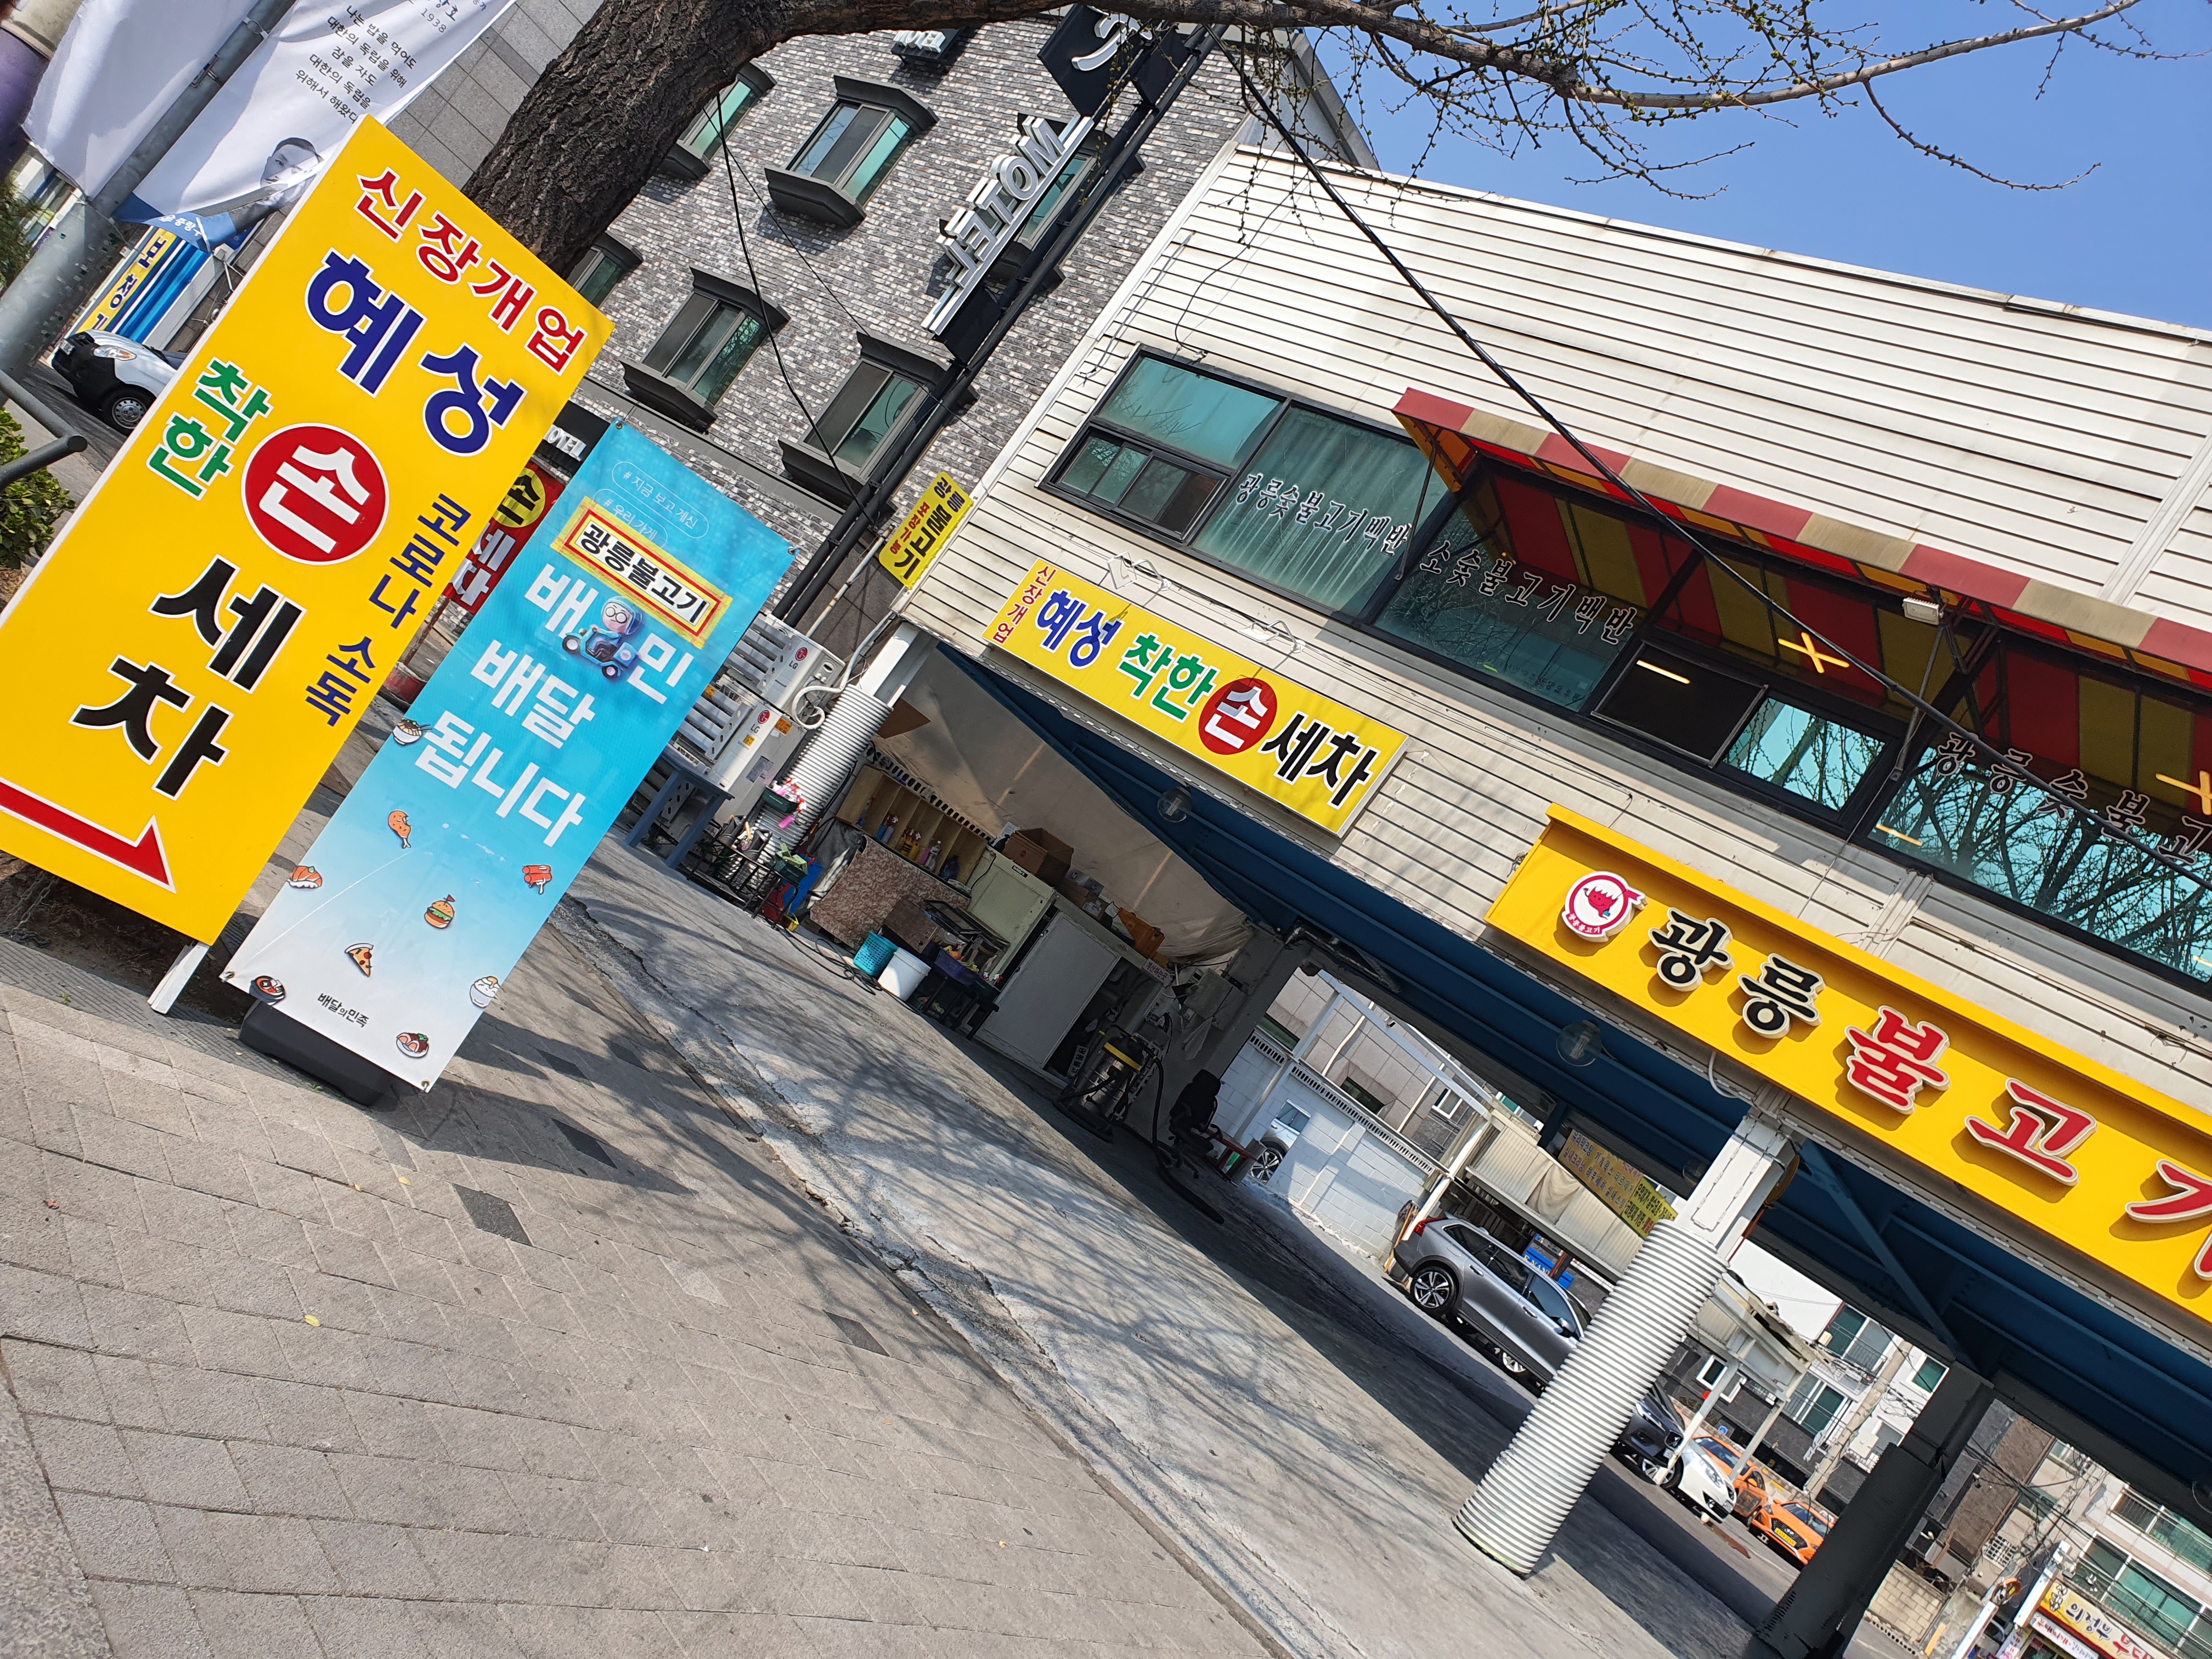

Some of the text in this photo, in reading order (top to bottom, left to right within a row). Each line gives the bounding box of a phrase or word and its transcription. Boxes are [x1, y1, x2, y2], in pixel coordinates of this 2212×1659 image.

[327, 16, 408, 89] 대한의 독립을 위해
[346, 5, 417, 70] 나는 밥을 먹어도
[421, 8, 447, 33] 1938
[295, 69, 330, 99] 위해서
[309, 54, 371, 110] 대한의 독립을
[332, 46, 377, 86] 잠을 자도
[356, 167, 588, 375] 신장개업
[306, 247, 528, 456] 혜성
[146, 357, 273, 500] 착한
[544, 424, 586, 461] OTEL
[259, 445, 372, 554] 손
[612, 504, 636, 526] 우리
[634, 519, 658, 541] 가게
[632, 476, 654, 498] 지금
[653, 492, 675, 514] 보고
[675, 507, 698, 529] 계신
[890, 501, 931, 555] 포장가능
[934, 477, 966, 512] 광릉
[1235, 472, 1412, 557] 광릉숯불고기백반
[580, 523, 707, 623] 광릉불고기
[894, 504, 953, 580] 불고기
[304, 493, 471, 727] 코로나 소독
[992, 566, 1057, 645] 신장개업
[1419, 539, 1637, 645] 소숯불고기백반
[69, 554, 307, 800] 세차
[470, 639, 596, 748] 배달
[789, 661, 798, 669] LG
[1035, 589, 1381, 810] 혜성 착한 손 세차
[750, 724, 760, 733] LG
[414, 711, 586, 847] 됩니다
[317, 993, 369, 1028] 배달의민족
[2066, 1602, 2112, 1640] 의정부
